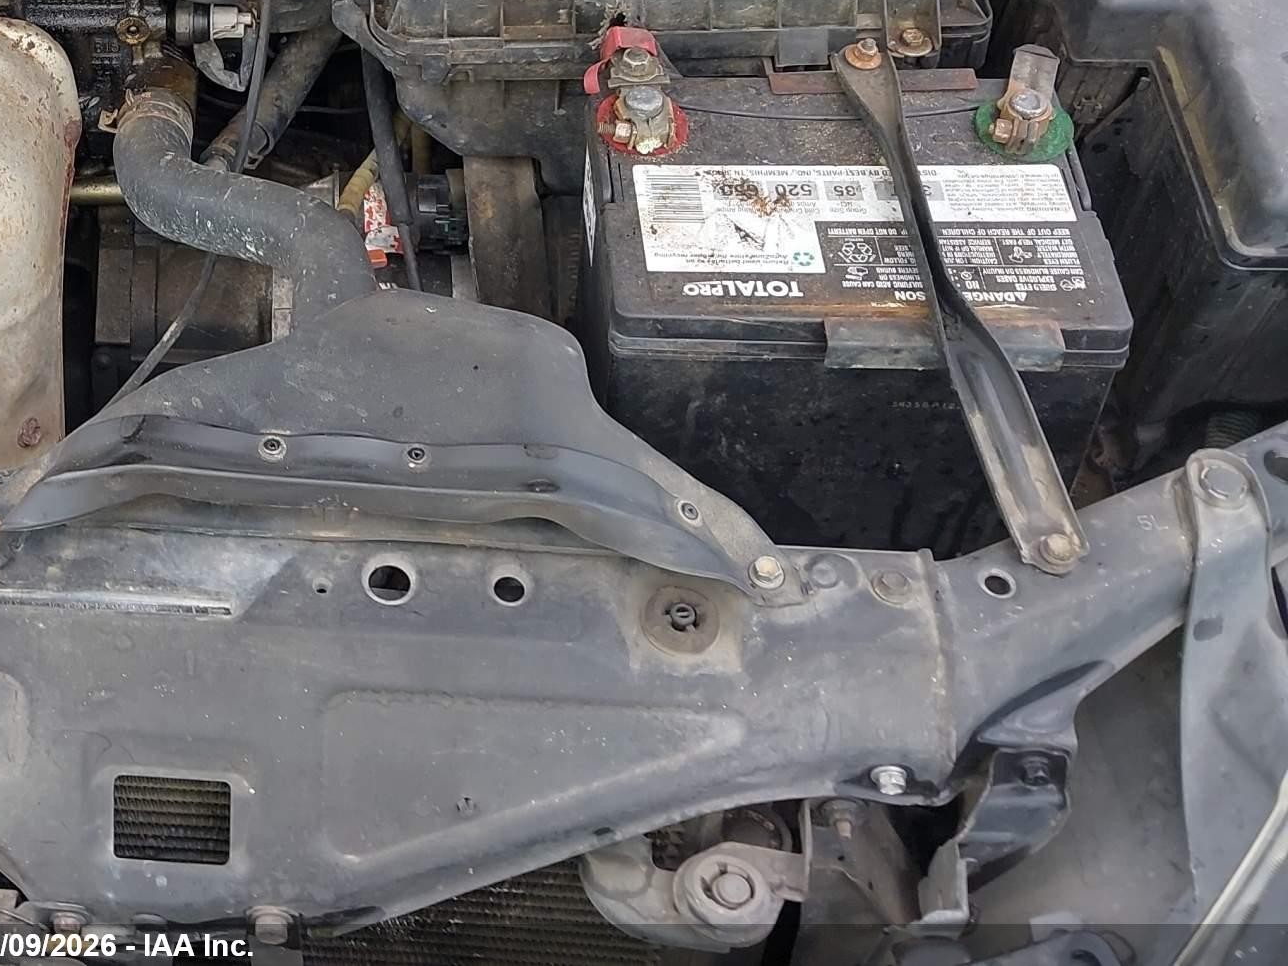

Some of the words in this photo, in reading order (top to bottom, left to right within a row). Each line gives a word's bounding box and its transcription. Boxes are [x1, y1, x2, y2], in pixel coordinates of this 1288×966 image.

[845, 169, 867, 177] BEST
[774, 184, 813, 197] 520
[833, 185, 857, 197] 35
[1011, 228, 1025, 236] THE
[1026, 228, 1037, 236] OF
[1037, 228, 1051, 236] OUT
[1053, 228, 1070, 236] KEEP
[1017, 275, 1054, 283] EXPLOSIVE
[841, 280, 862, 288] CAUSE
[862, 280, 875, 288] CAN
[875, 280, 892, 288] ACID
[892, 280, 924, 288] SULFURIC
[965, 280, 980, 290] NO
[1014, 283, 1032, 291] EYES
[1033, 283, 1057, 291] SHIELD
[683, 280, 804, 298] TOTALPRO
[894, 290, 927, 301] SON
[961, 291, 1016, 302] DANGE
